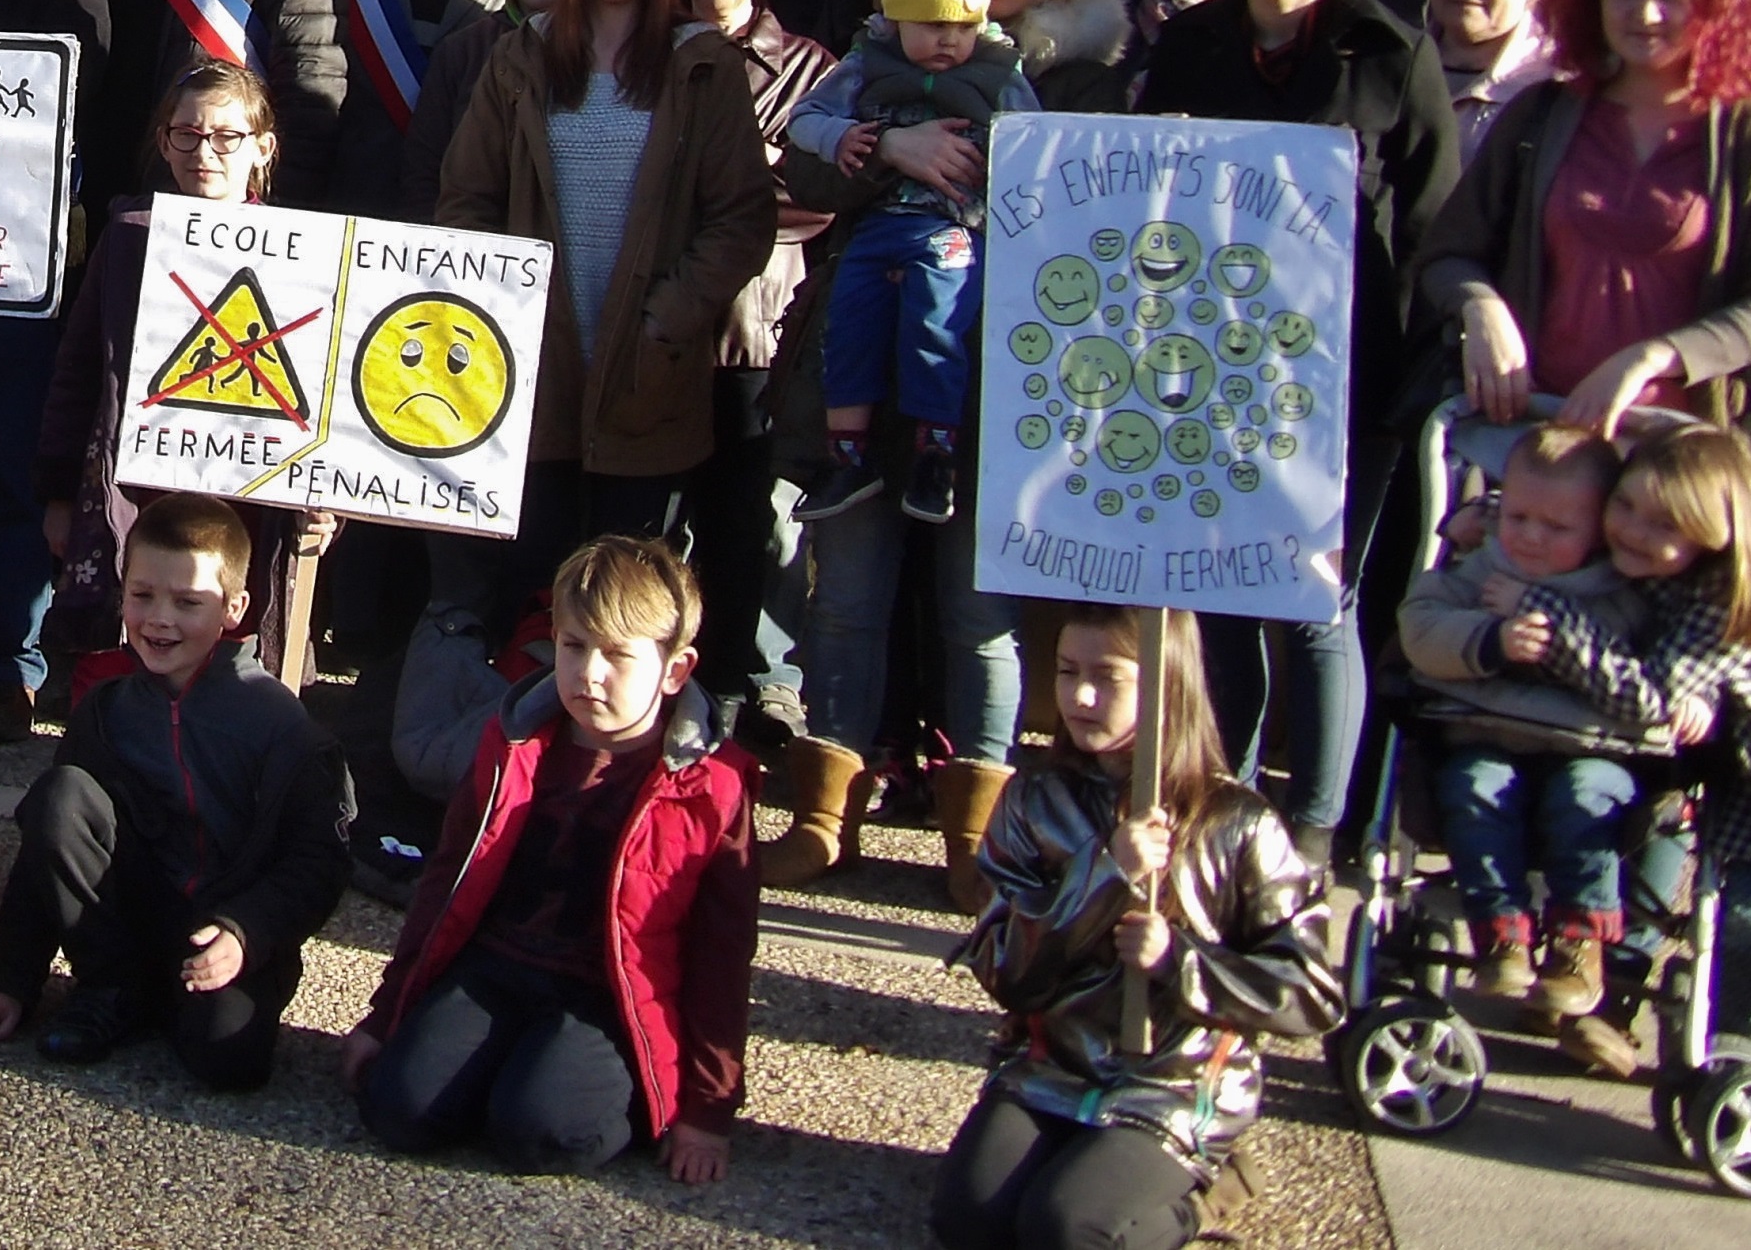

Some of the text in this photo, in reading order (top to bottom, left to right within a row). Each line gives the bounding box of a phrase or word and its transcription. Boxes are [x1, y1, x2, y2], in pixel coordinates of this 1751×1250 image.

[991, 184, 1044, 239] LES
[1058, 150, 1206, 207] ENFANTS
[1214, 161, 1294, 225] SONT
[357, 240, 539, 287] ENFANTS
[1163, 542, 1278, 593] FERMER
